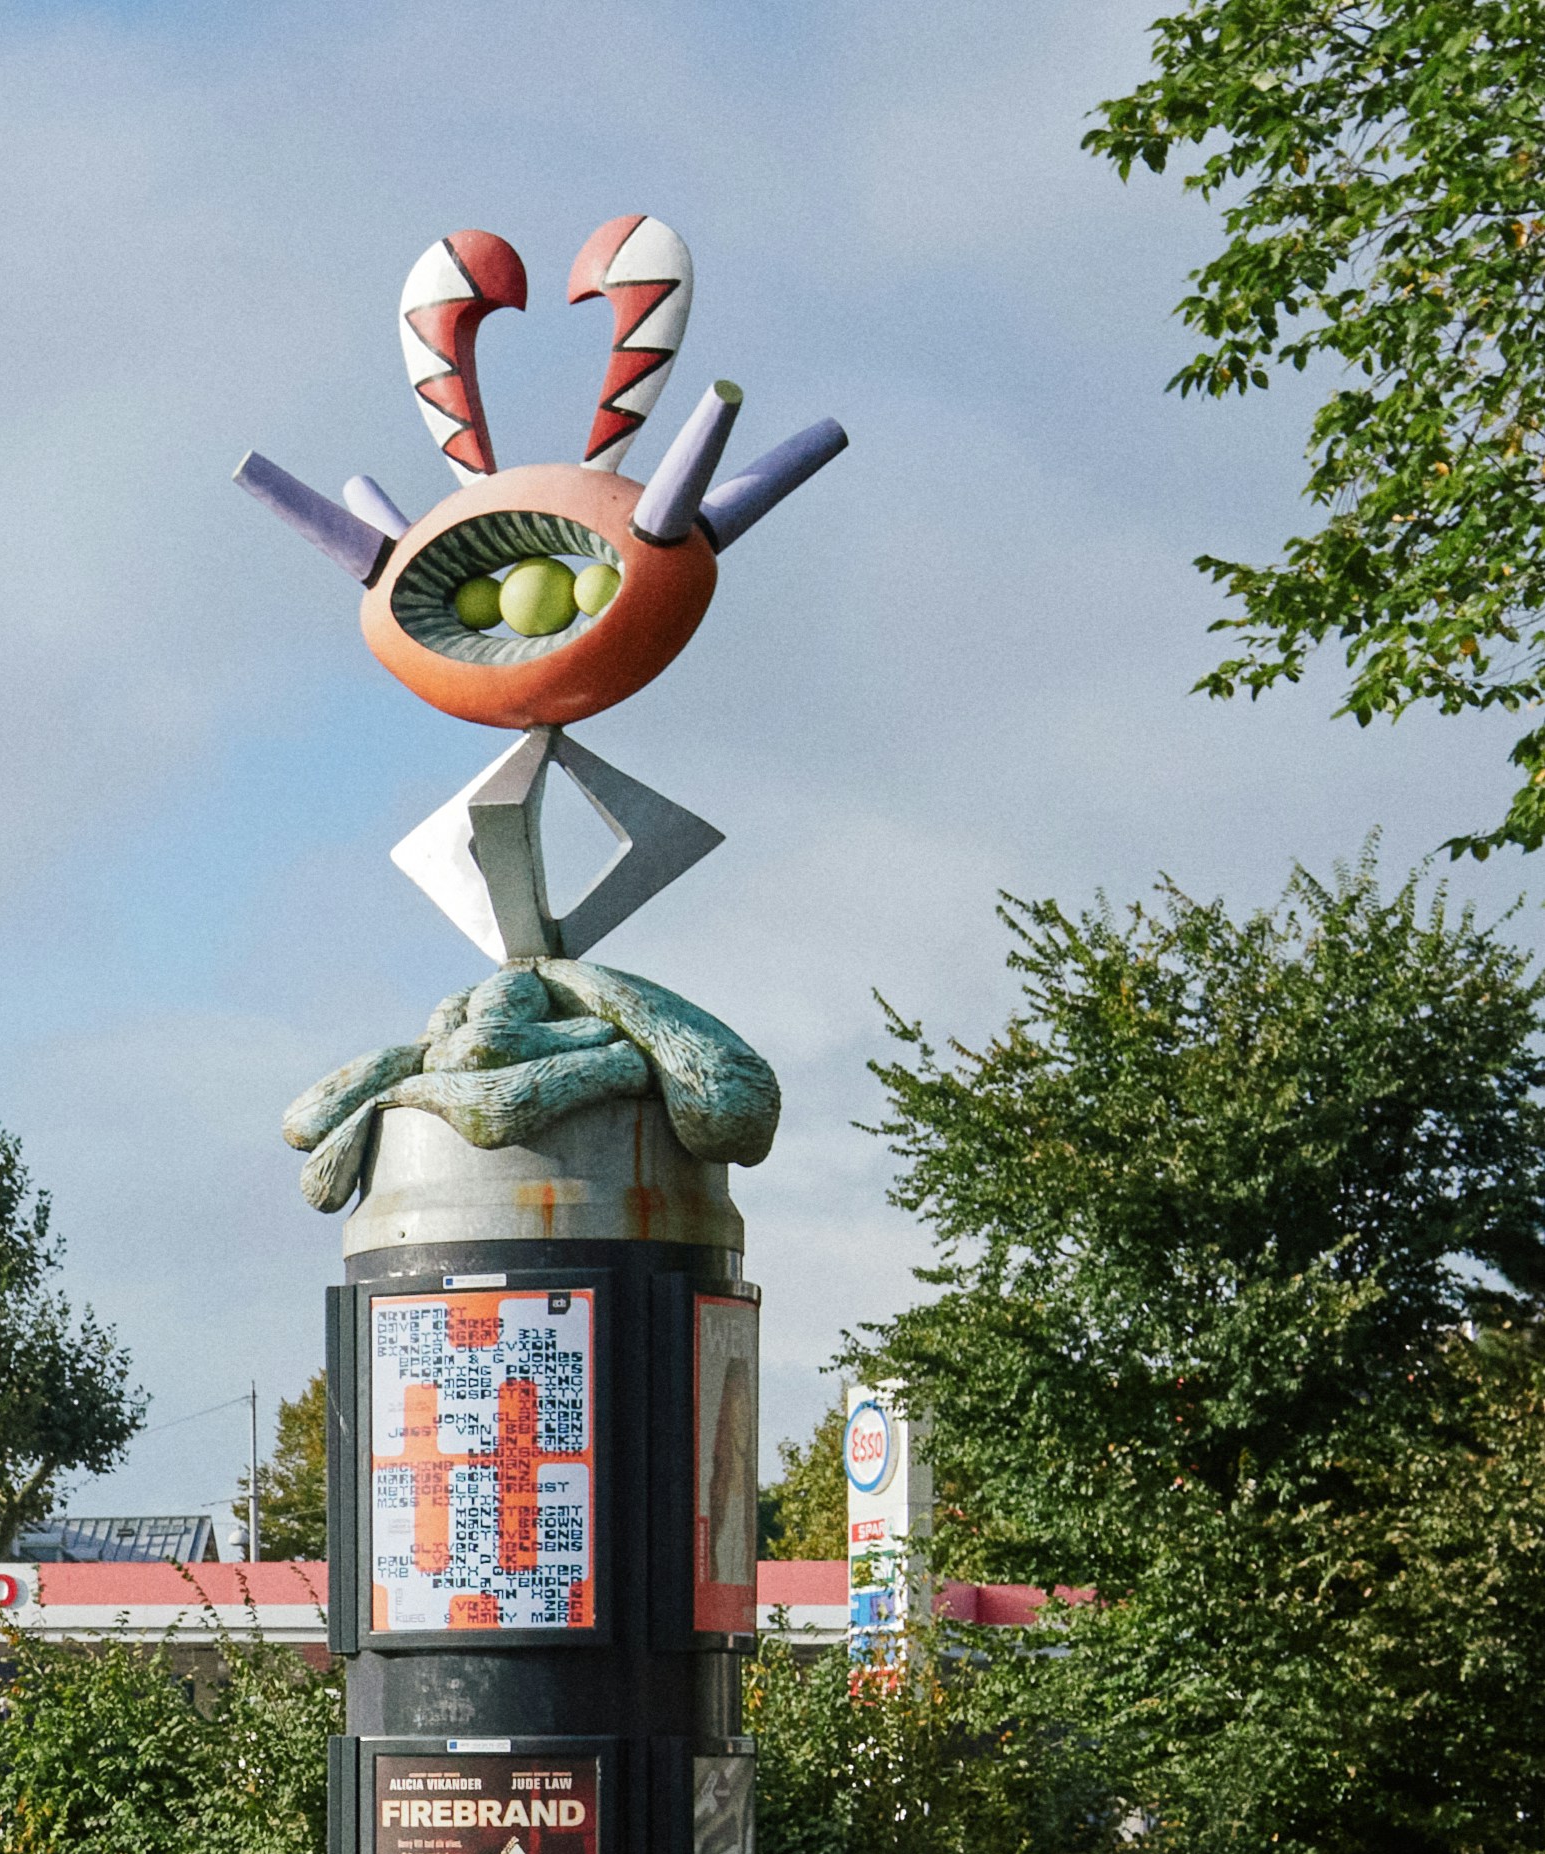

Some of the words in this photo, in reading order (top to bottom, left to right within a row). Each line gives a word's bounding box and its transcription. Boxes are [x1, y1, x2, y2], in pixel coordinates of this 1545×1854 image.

[389, 1778, 423, 1791] ALICIA
[427, 1777, 482, 1790] VIKANDER
[511, 1777, 541, 1790] JUDE
[545, 1777, 573, 1790] LAW
[382, 1799, 586, 1828] FIREBRAND
